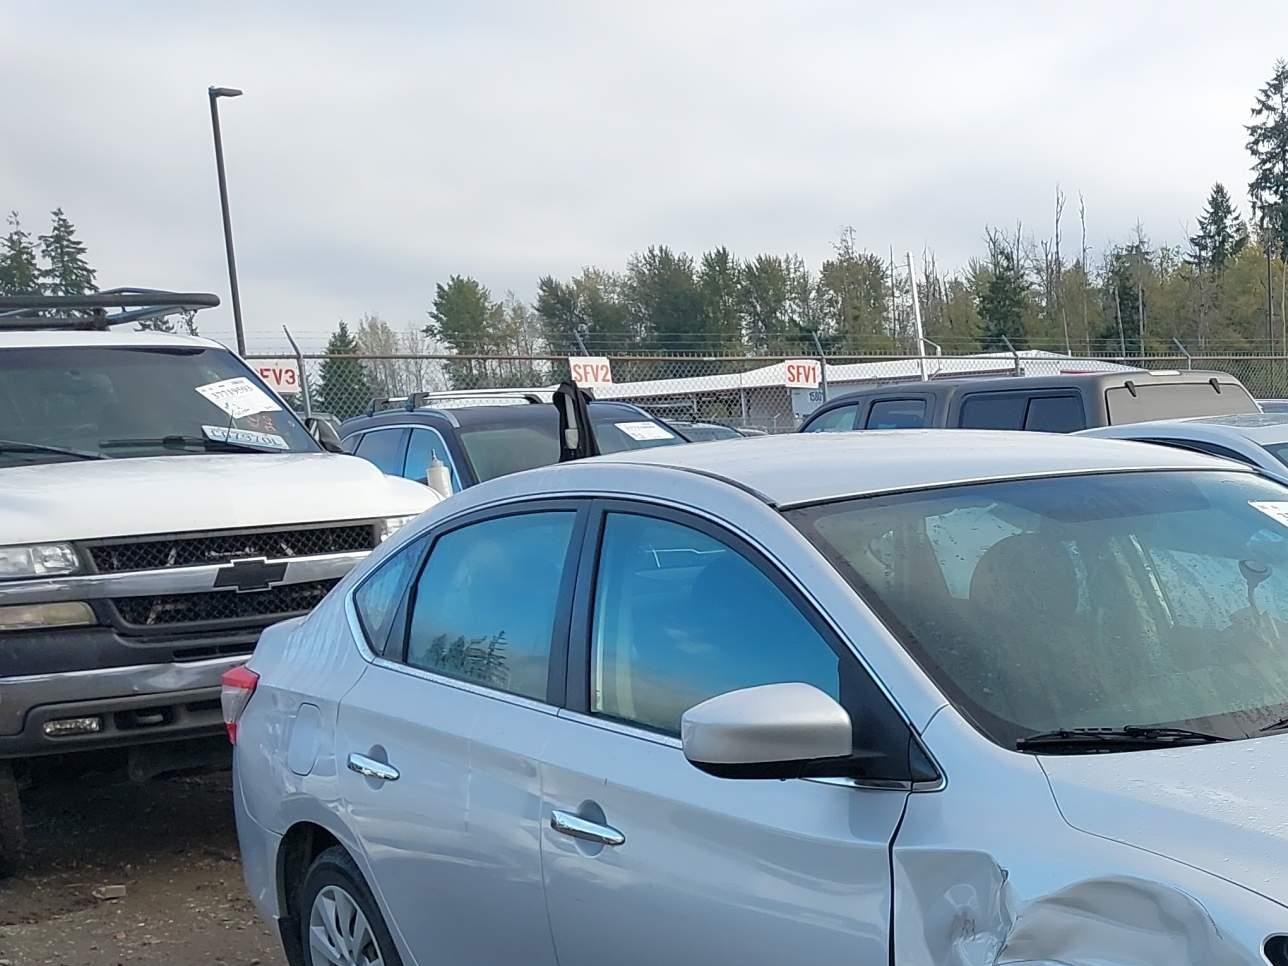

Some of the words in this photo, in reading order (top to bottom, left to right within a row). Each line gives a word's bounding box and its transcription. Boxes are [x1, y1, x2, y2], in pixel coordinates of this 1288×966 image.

[256, 368, 296, 386] FV3
[573, 364, 610, 383] SFV2
[787, 364, 816, 384] SFV1
